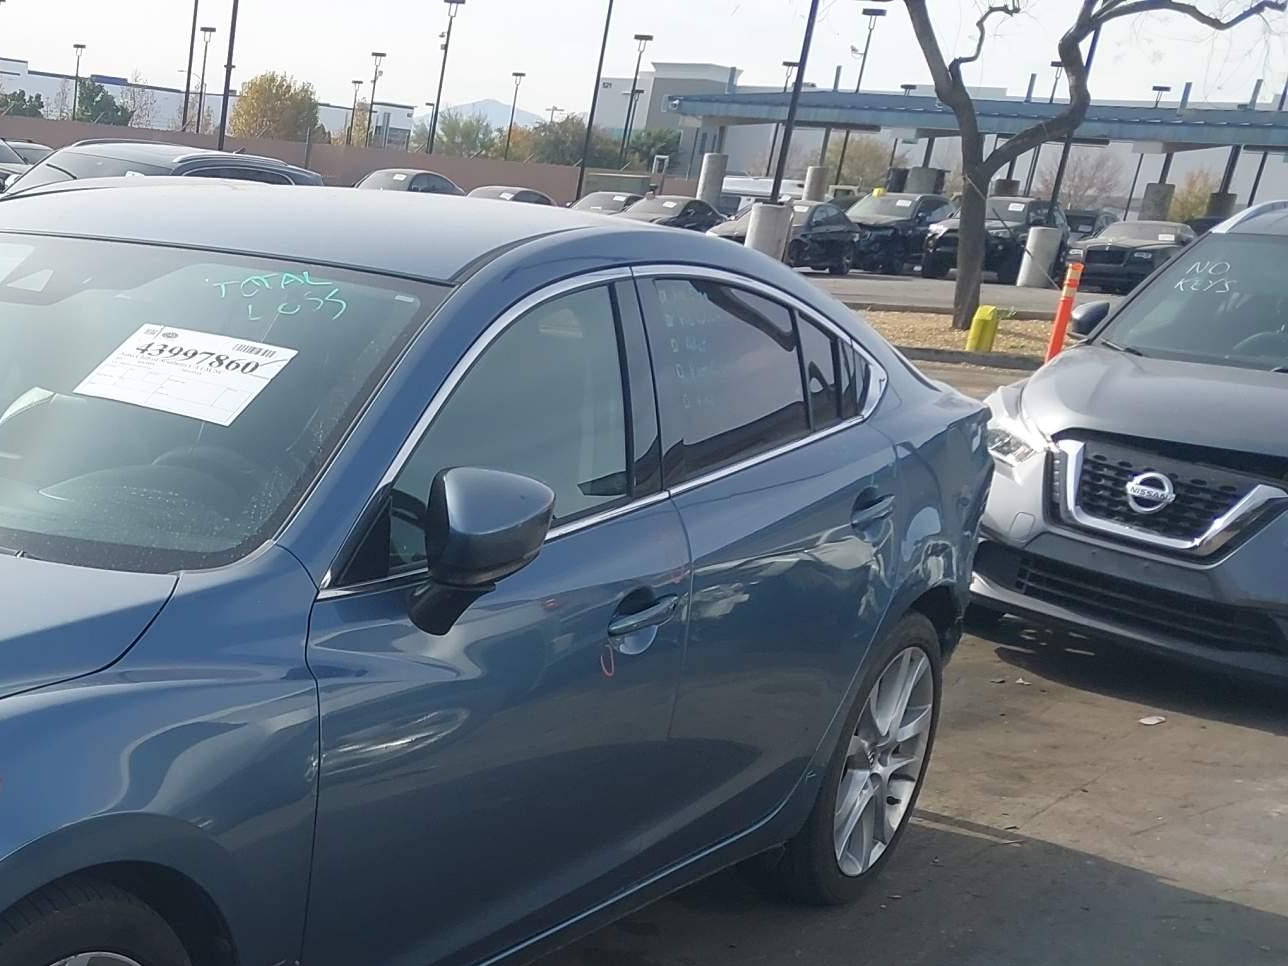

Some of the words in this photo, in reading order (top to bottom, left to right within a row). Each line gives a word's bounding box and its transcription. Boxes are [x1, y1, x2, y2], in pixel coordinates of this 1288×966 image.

[1185, 260, 1231, 276] NO
[213, 271, 333, 299] TOTAL
[1174, 277, 1239, 294] KEYS
[136, 341, 260, 376] 43997860
[1130, 485, 1169, 501] NISSAN
